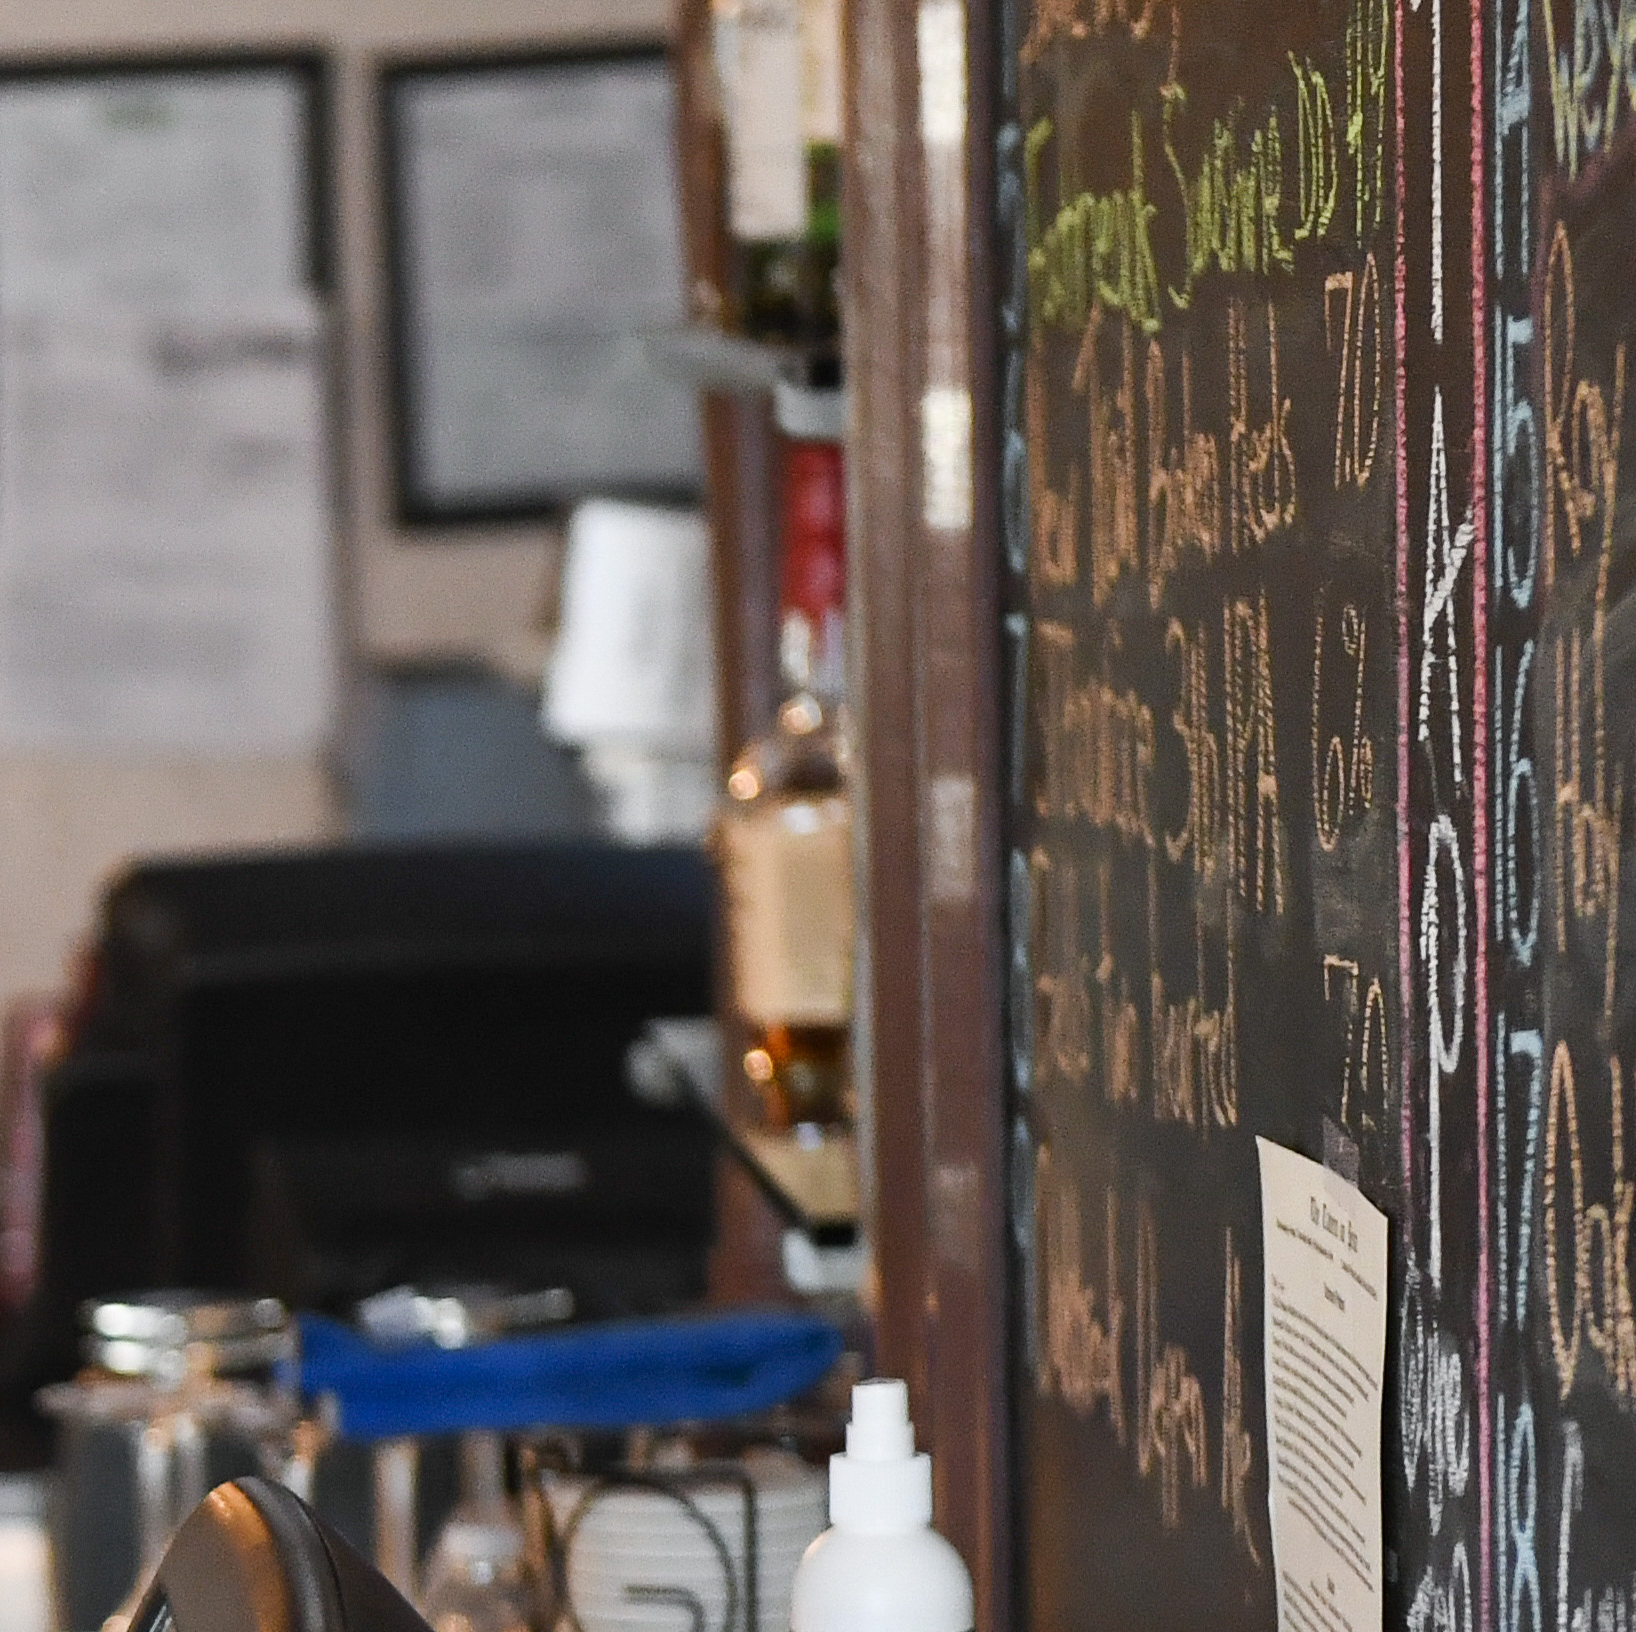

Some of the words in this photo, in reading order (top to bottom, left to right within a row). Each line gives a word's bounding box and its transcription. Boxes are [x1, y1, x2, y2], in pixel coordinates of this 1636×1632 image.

[1493, 302, 1539, 610] 15
[1222, 582, 1284, 914] IPA
[1311, 584, 1375, 853] 6%
[1494, 638, 1541, 967] 16
[1495, 1008, 1544, 1330] 17
